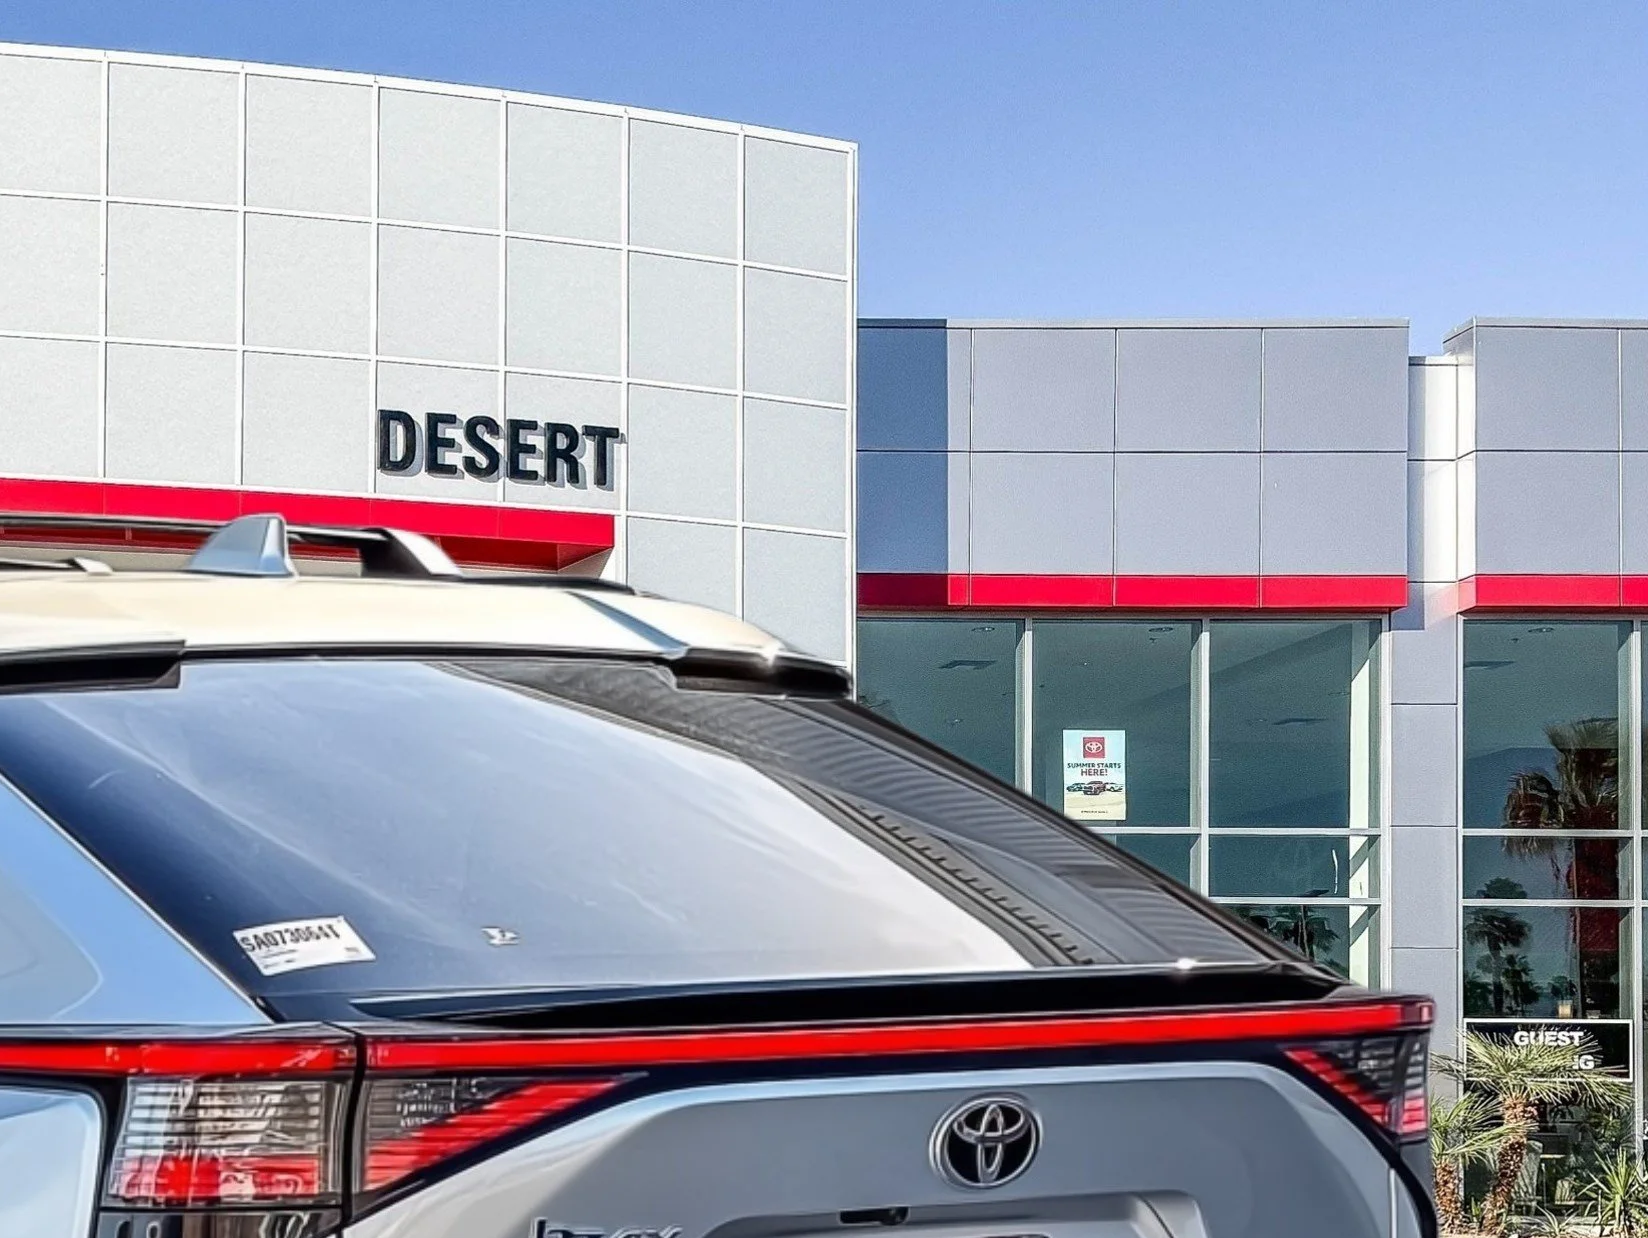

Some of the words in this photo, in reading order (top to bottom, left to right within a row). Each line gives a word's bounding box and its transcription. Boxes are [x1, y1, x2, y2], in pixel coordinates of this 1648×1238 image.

[377, 409, 620, 487] DESERT
[1080, 768, 1108, 777] HERE!
[1513, 1030, 1584, 1046] GUEST
